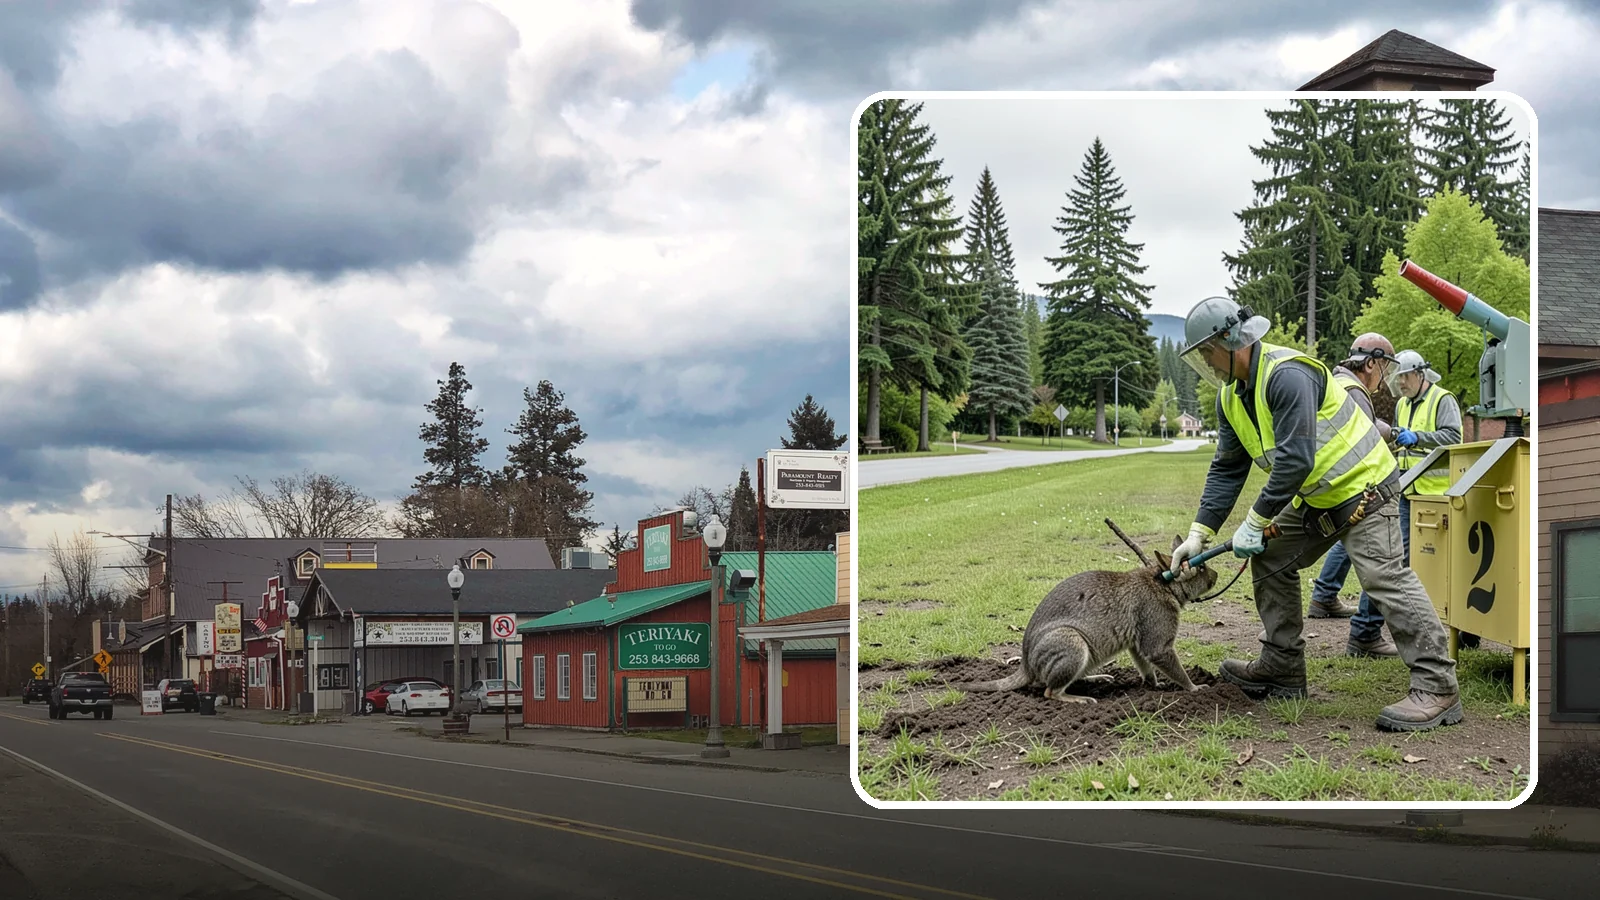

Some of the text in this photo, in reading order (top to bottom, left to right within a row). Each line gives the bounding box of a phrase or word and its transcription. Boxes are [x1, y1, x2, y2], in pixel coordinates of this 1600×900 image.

[817, 472, 839, 480] REALTY
[1467, 520, 1496, 615] 2
[624, 627, 702, 646] TERIYAKI
[628, 653, 700, 664] 253 843-9668
[639, 681, 673, 691] TERIYAKI
